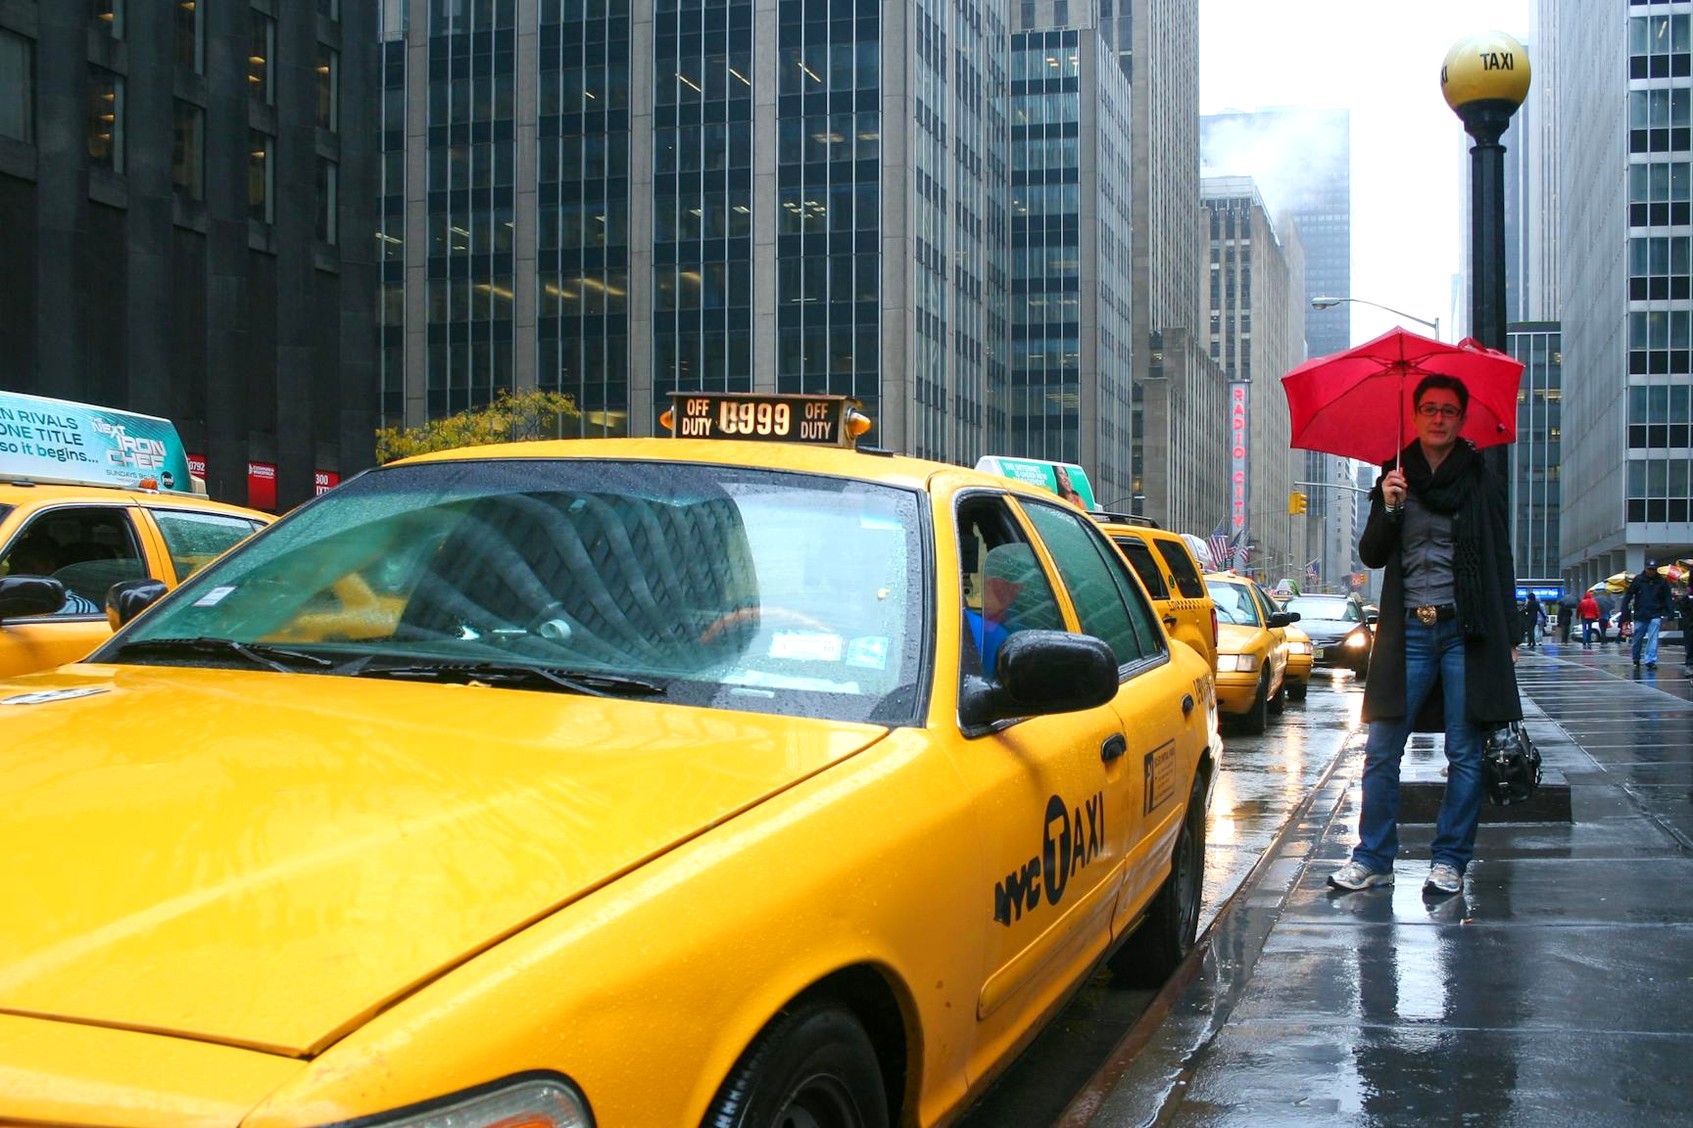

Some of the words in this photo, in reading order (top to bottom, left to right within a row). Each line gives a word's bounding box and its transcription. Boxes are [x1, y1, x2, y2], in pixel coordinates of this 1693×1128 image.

[1480, 52, 1513, 71] TAXI
[687, 399, 710, 416] OFF
[806, 402, 829, 419] OFF
[17, 410, 79, 430] RIVALS
[93, 420, 126, 438] NEXT
[682, 417, 712, 436] DUTY
[1232, 387, 1246, 460] RADIO
[0, 423, 33, 440] ONE
[35, 428, 84, 446] TITLE
[800, 421, 832, 440] DUTY
[0, 442, 18, 453] so
[21, 441, 34, 455] it
[36, 444, 99, 463] begins...
[115, 435, 167, 456] IRON
[107, 449, 165, 470] CHEF
[106, 469, 138, 479] SUNDAYS
[315, 473, 329, 486] 300
[1232, 470, 1246, 527] CITY
[993, 856, 1042, 927] NYC
[1045, 791, 1104, 898] TAXI
